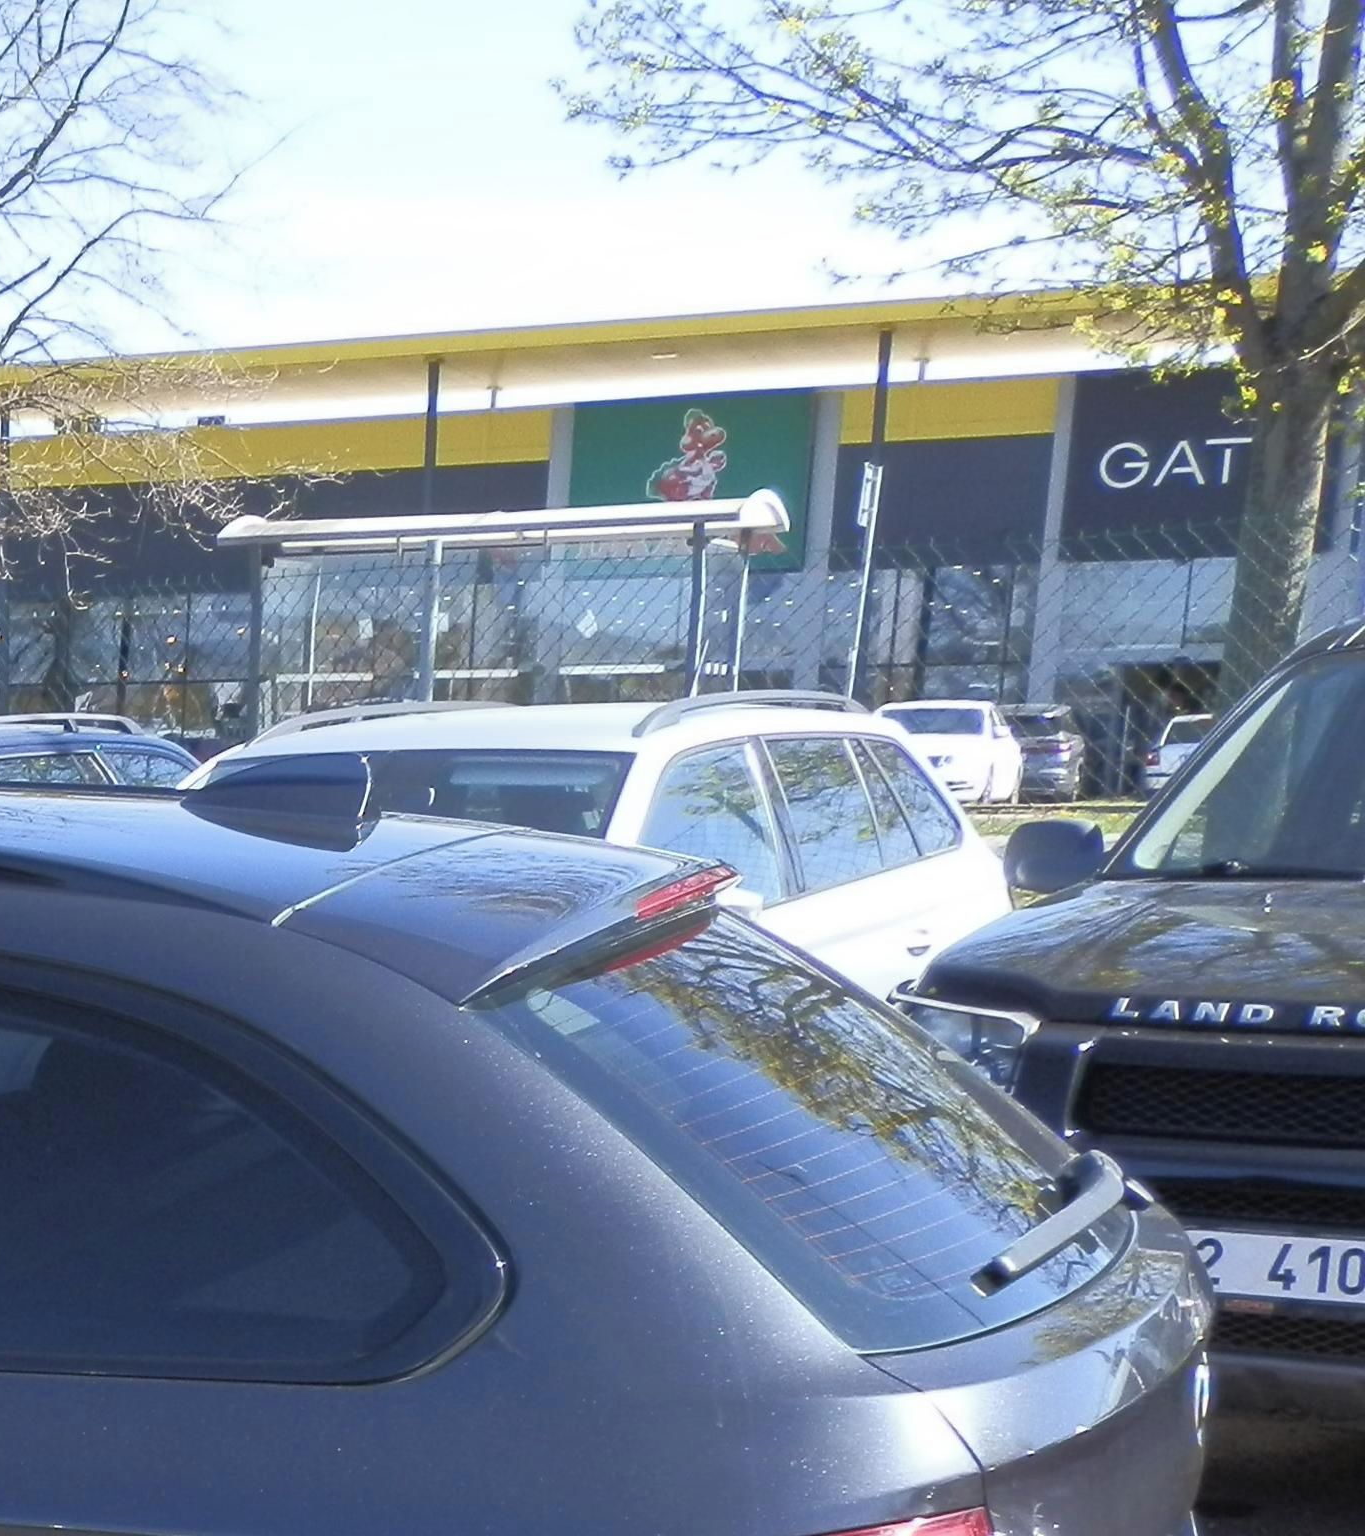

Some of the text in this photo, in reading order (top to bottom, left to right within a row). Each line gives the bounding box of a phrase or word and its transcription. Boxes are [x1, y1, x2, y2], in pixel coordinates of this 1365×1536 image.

[1099, 437, 1254, 489] GAT
[1112, 997, 1275, 1025] LAND
[1266, 1243, 1365, 1296] 410
